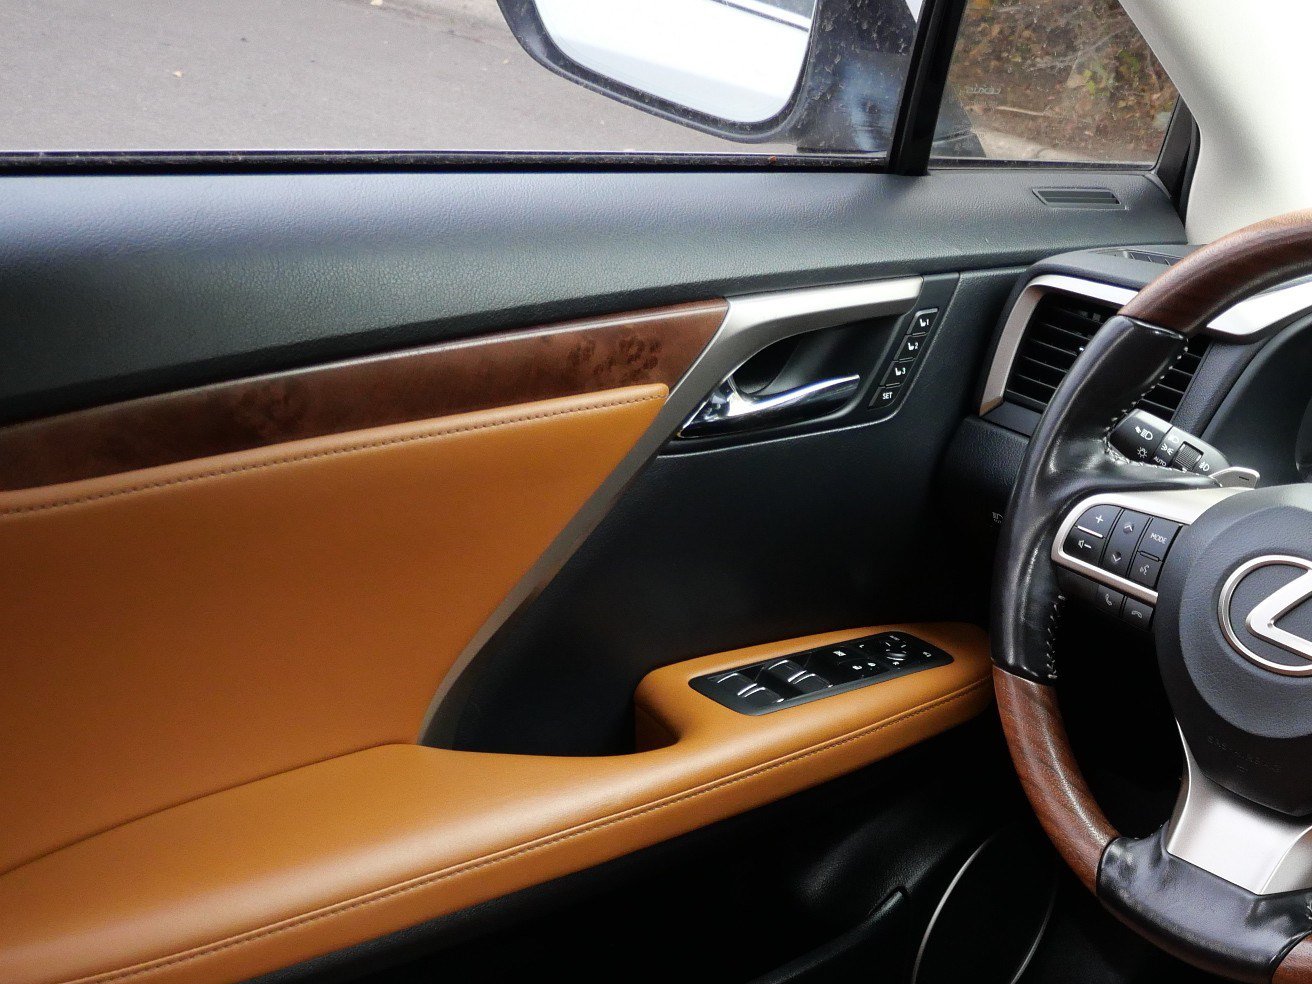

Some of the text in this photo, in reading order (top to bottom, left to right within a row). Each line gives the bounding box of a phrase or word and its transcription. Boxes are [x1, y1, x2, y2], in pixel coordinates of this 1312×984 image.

[882, 391, 893, 400] SET
[1153, 456, 1168, 467] AUTO
[1149, 532, 1168, 545] MODE
